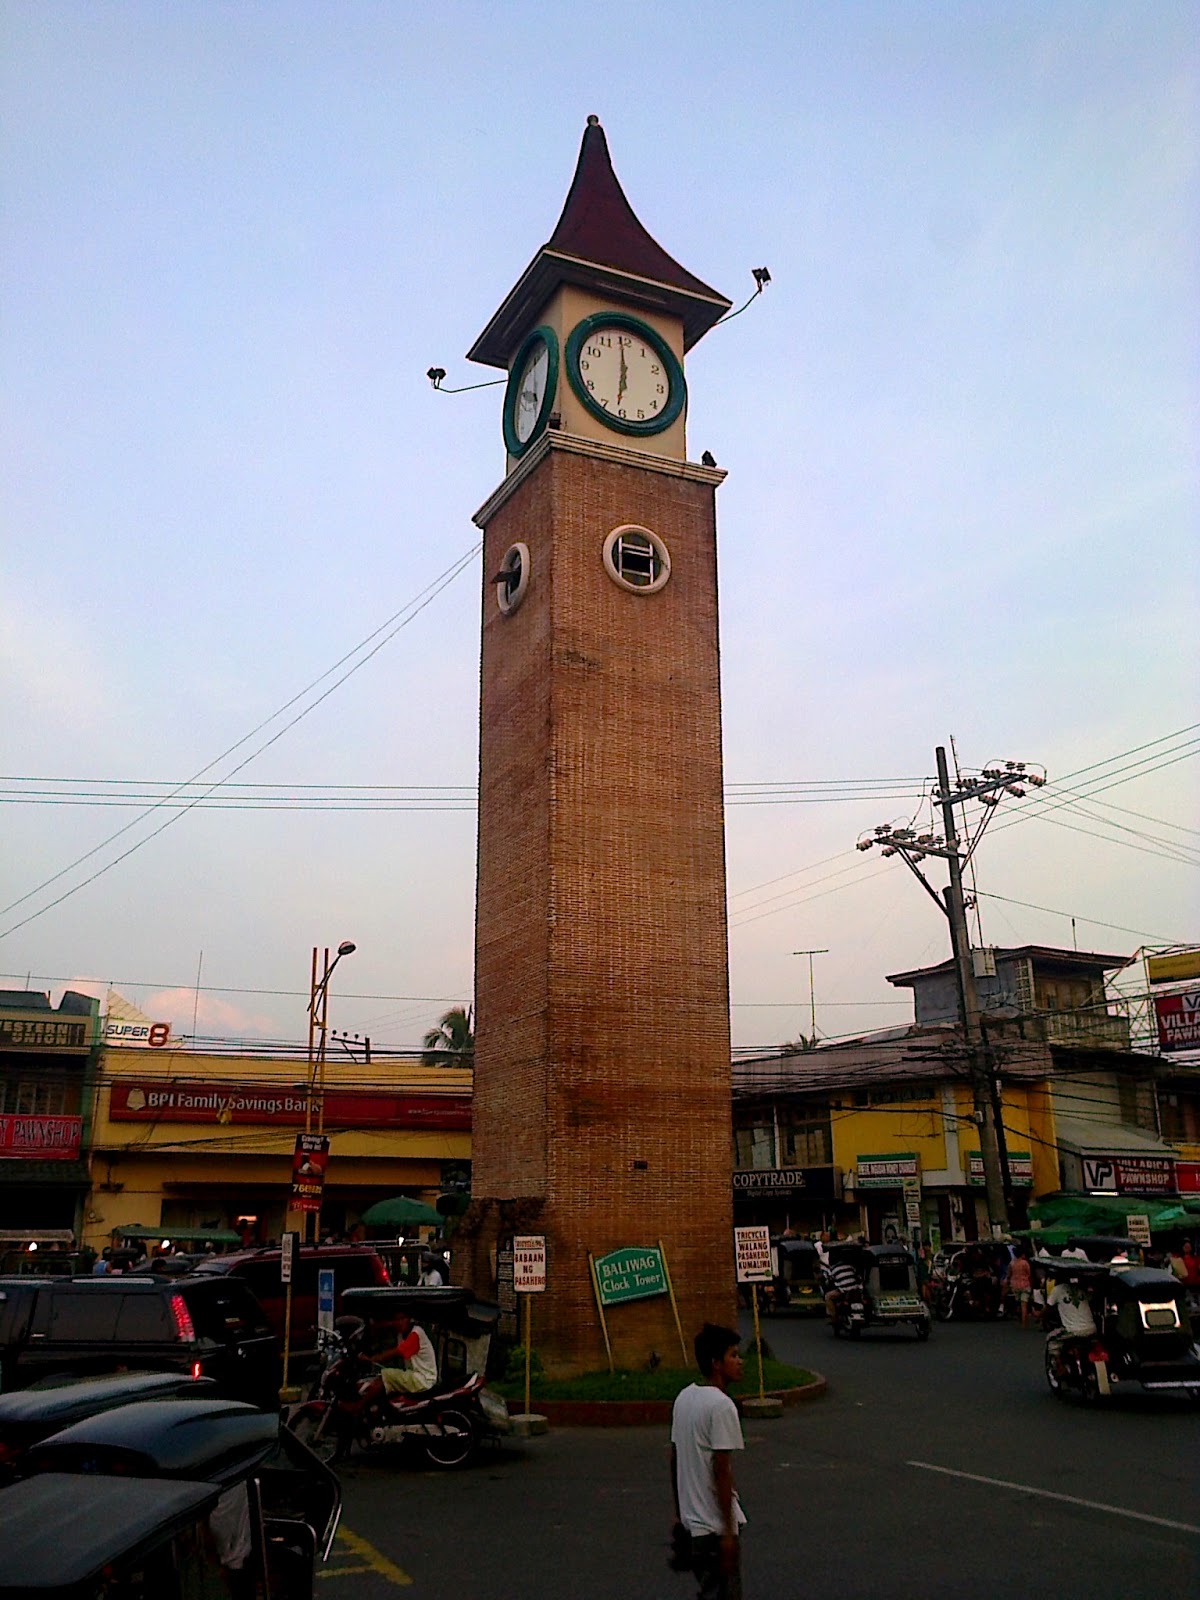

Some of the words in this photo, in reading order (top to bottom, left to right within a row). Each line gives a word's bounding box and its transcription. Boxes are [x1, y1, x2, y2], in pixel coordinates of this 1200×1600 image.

[600, 336, 612, 348] 11
[617, 336, 632, 348] 12
[587, 346, 601, 358] 10
[640, 348, 646, 358] 1
[581, 360, 589, 370] 9
[651, 365, 659, 375] 2
[586, 380, 595, 390] 8
[656, 384, 664, 394] 3
[600, 399, 609, 408] 7
[649, 400, 658, 410] 4
[618, 409, 627, 419] 6
[637, 409, 645, 420] 5
[0, 1020, 69, 1034] ESTERN
[11, 1032, 69, 1044] UNION
[106, 1023, 149, 1037] SUPER
[148, 1023, 170, 1047] 8
[148, 1093, 173, 1107] BPI
[177, 1093, 226, 1110] Family
[228, 1096, 283, 1113] Savings
[14, 1119, 80, 1148] PAWNSHOP
[1086, 1161, 1113, 1186] VP
[1120, 1173, 1170, 1185] PAWNSHOP
[733, 1172, 803, 1187] COPYTRADE
[737, 1231, 766, 1240] TRICYCLE
[739, 1242, 767, 1251] WALANG
[515, 1254, 543, 1262] BABAAN
[523, 1265, 533, 1274] NG
[602, 1256, 655, 1277] BALIWAG
[515, 1276, 545, 1285] PASAHERO
[603, 1277, 630, 1292] Clock
[633, 1273, 660, 1287] Tower
